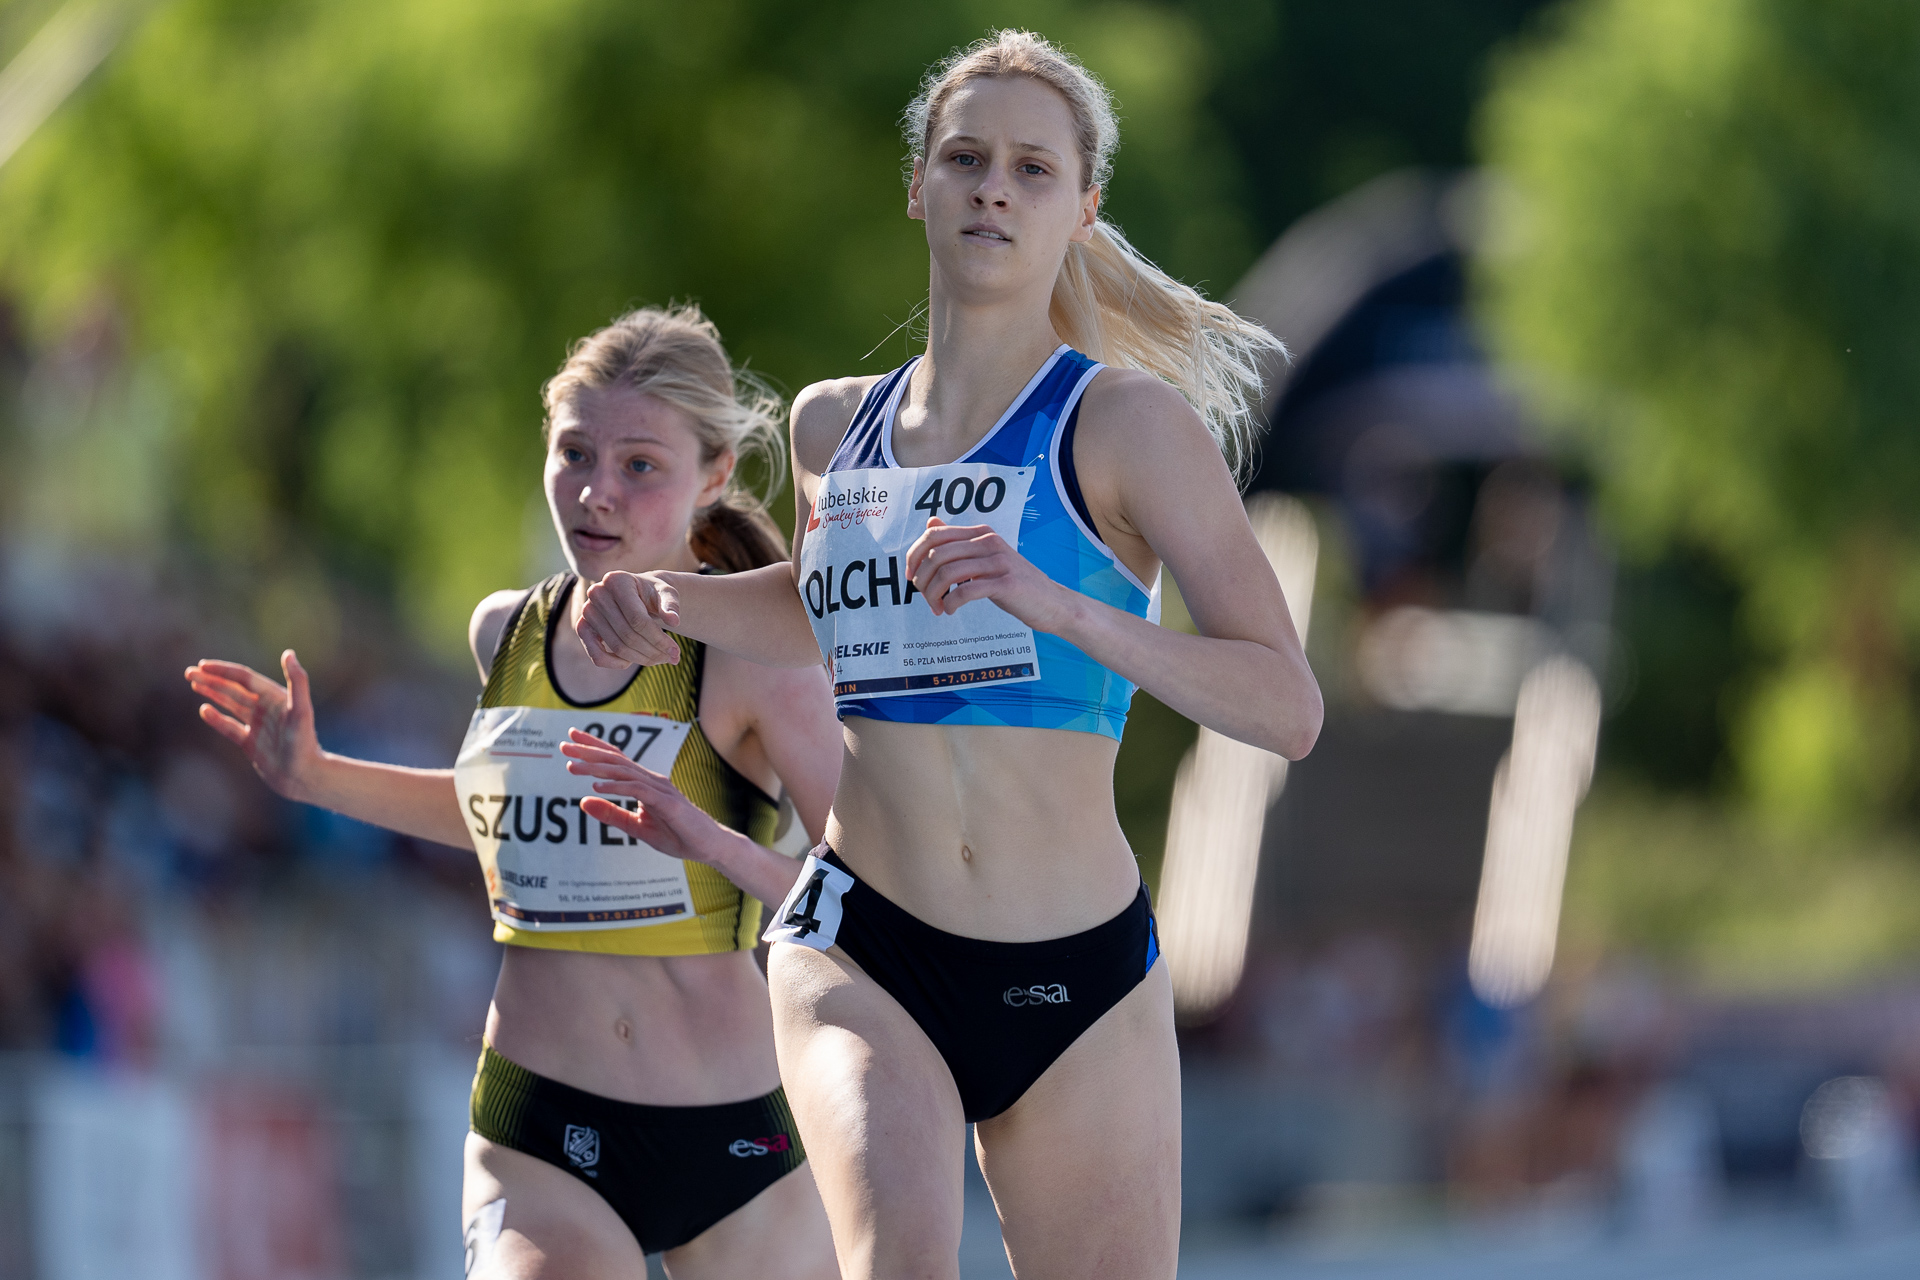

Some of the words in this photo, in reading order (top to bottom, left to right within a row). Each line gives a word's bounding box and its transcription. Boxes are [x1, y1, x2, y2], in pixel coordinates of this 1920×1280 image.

[914, 476, 1006, 517] 400
[915, 640, 958, 650] Ogólnopolska
[958, 635, 994, 645] Olimpiada
[903, 659, 916, 667] 56.
[917, 657, 936, 665] PZLA
[937, 651, 988, 664] Mistrzostwa
[990, 647, 1015, 657] Polski
[1016, 646, 1031, 654] U18
[932, 668, 1012, 685] 5-7.07.2024
[784, 868, 829, 939] 4
[1003, 983, 1071, 1007] esa
[729, 1132, 790, 1158] esa
